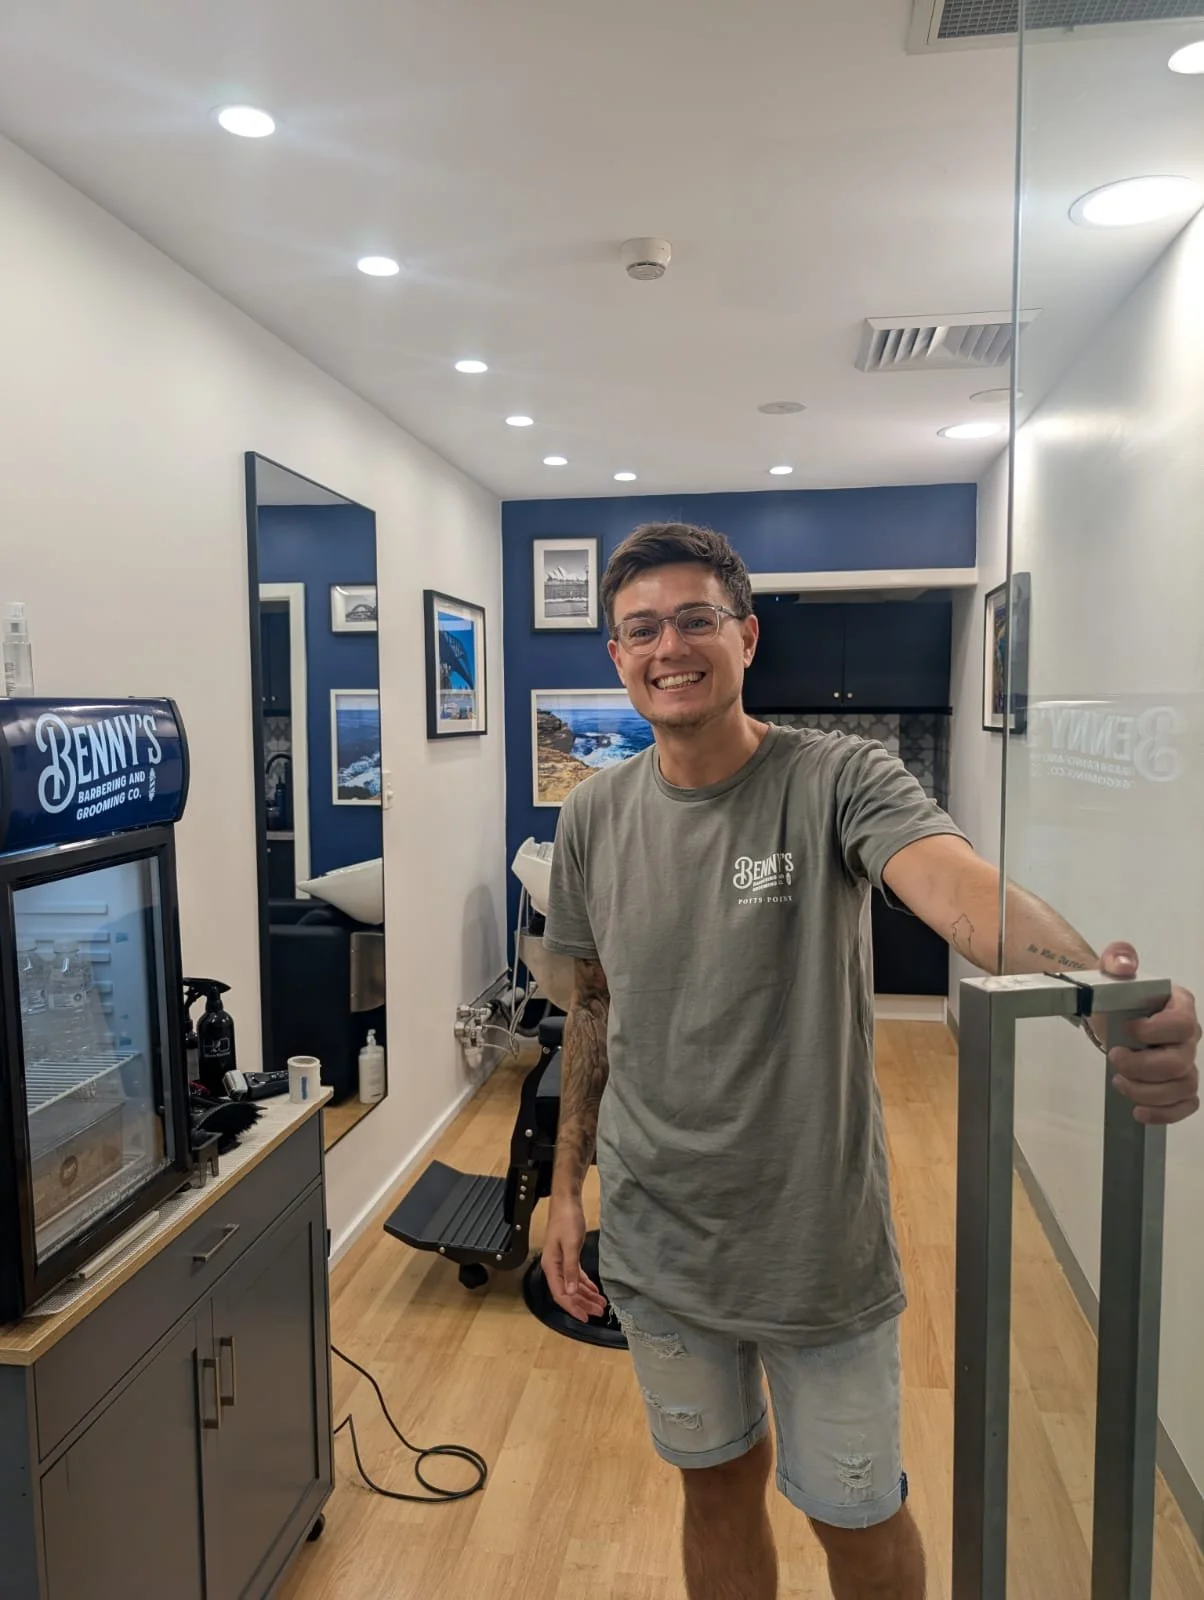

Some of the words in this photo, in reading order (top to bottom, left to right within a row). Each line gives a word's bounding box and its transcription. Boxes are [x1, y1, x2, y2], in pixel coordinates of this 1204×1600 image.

[35, 712, 162, 814] BENNY'S
[76, 792, 126, 821] GROOMING
[127, 787, 142, 801] CO.
[78, 775, 127, 804] BARBERING
[129, 770, 146, 785] AND
[732, 852, 794, 890] BENNY'S
